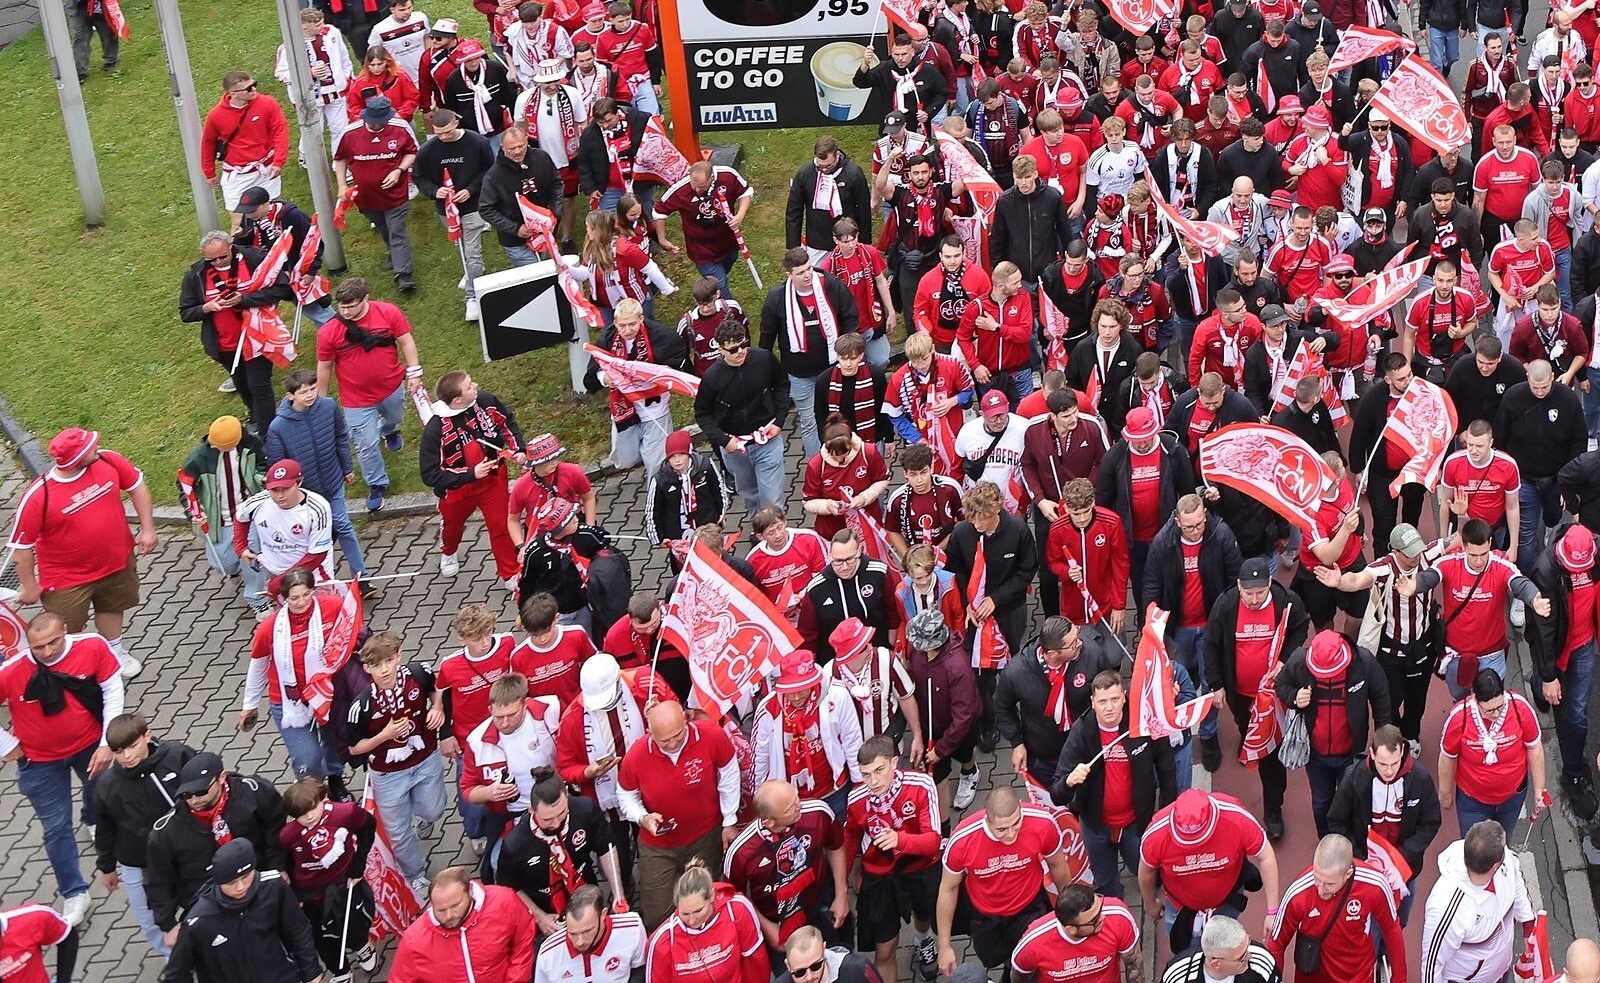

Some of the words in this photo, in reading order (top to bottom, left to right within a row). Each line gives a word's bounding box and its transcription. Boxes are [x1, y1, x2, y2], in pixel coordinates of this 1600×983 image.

[694, 45, 805, 68] COFFEE
[697, 70, 734, 90] TO
[743, 68, 785, 90] GO
[703, 105, 775, 124] LAVAZZA
[440, 157, 465, 165] AWAKE
[713, 646, 756, 692] FCN
